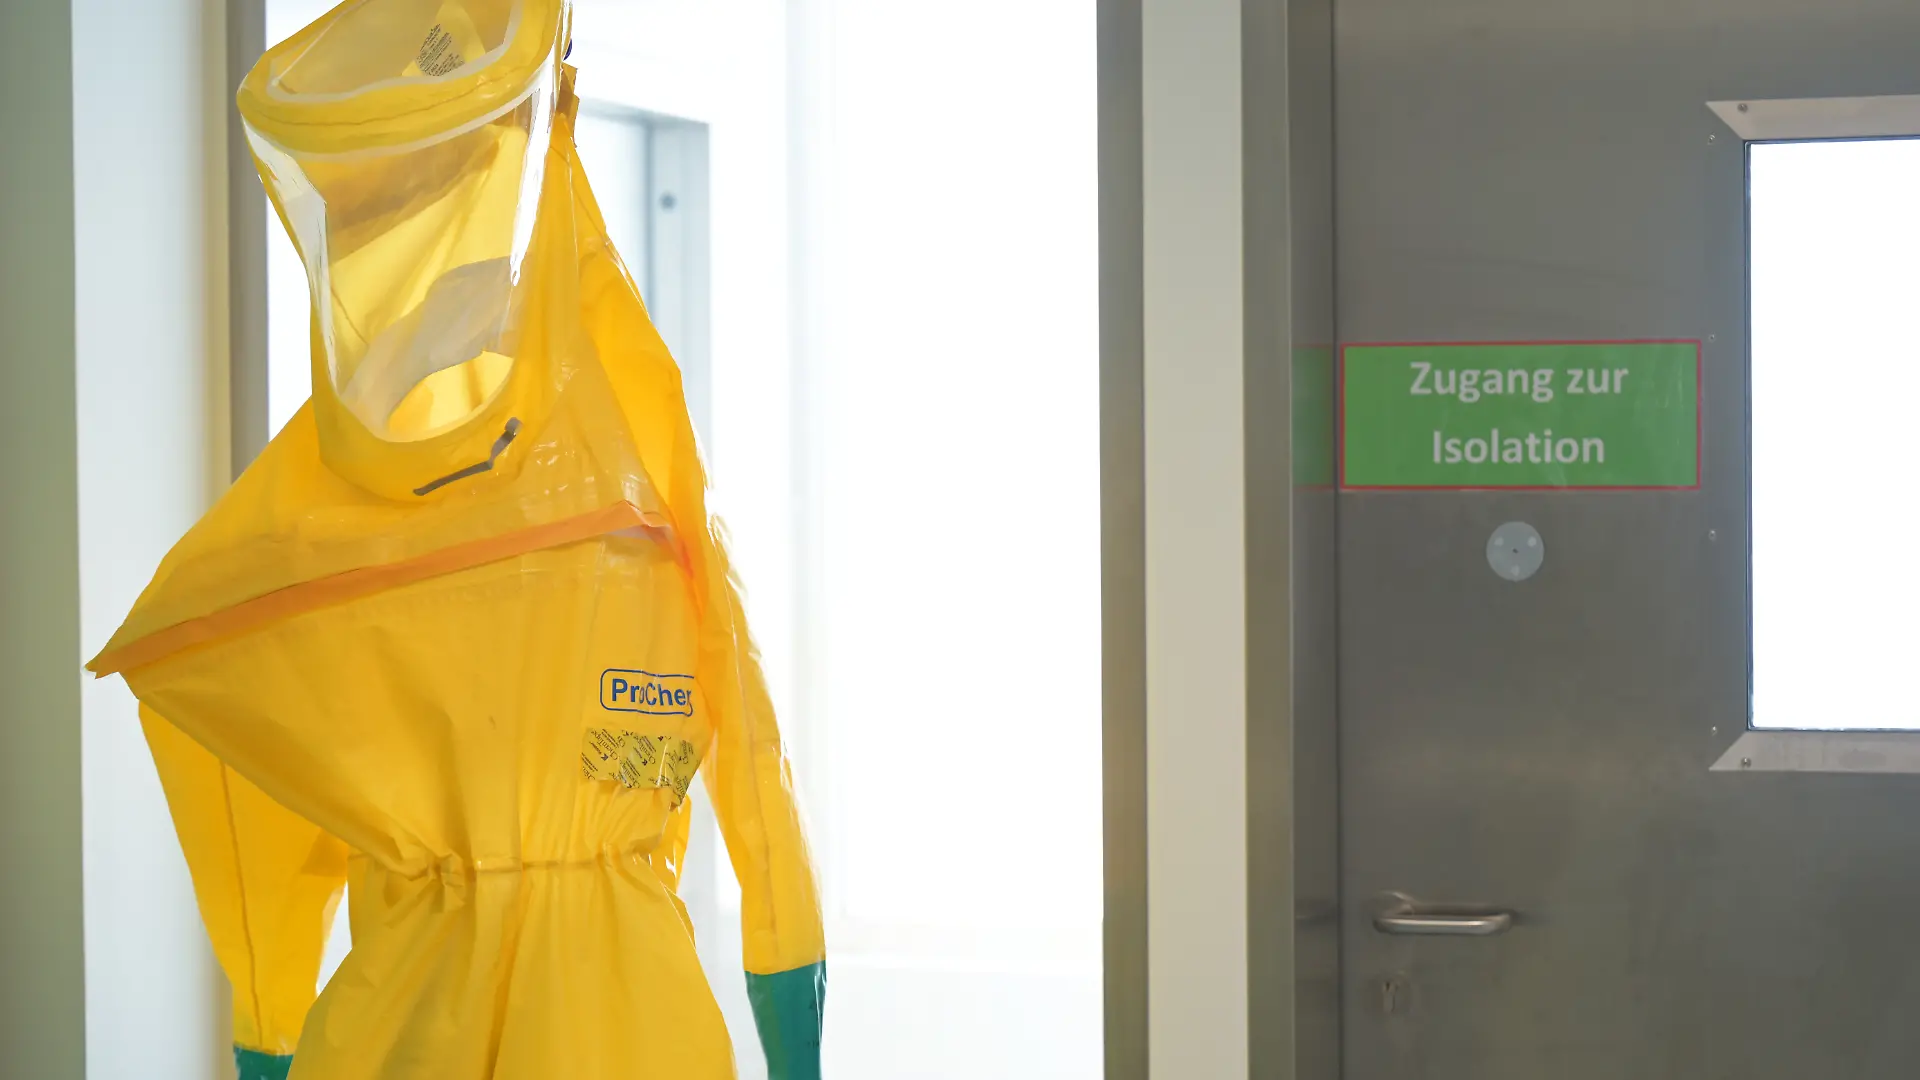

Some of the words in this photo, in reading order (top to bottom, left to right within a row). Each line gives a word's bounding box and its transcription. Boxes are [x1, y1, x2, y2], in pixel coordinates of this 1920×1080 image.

[1409, 361, 1554, 403] Zugang
[1567, 366, 1629, 395] zur
[1432, 428, 1605, 464] Isolation
